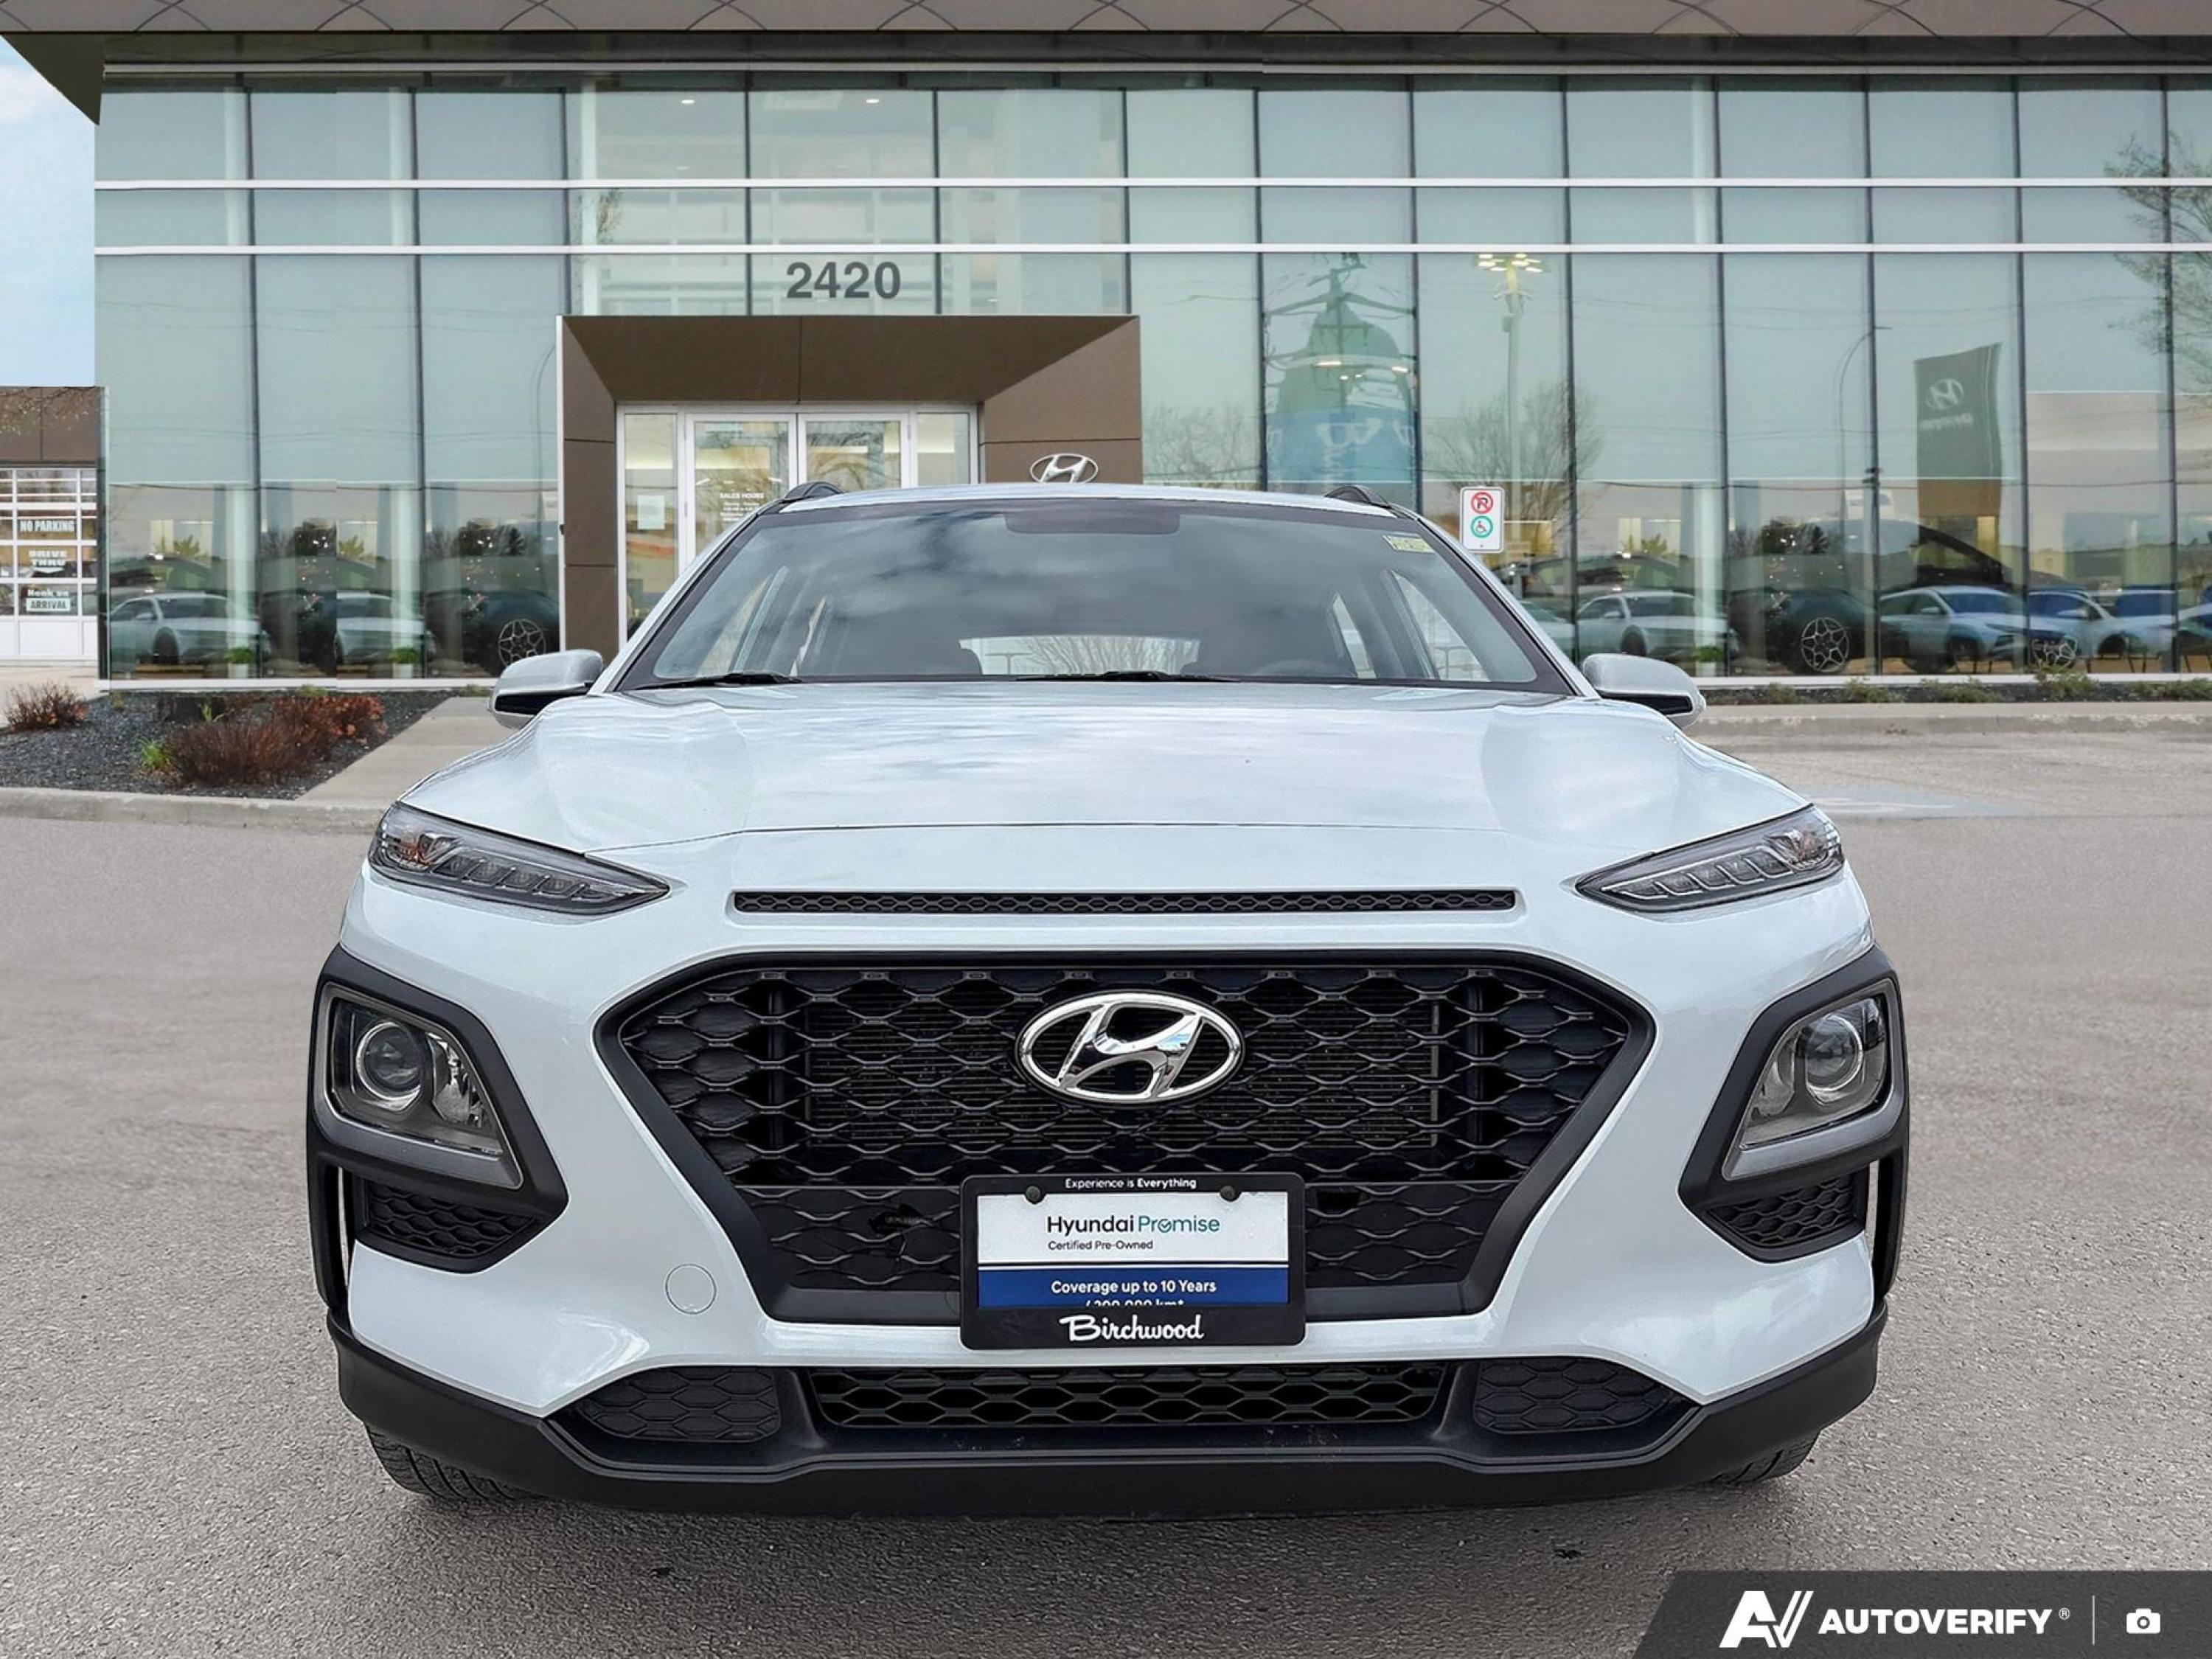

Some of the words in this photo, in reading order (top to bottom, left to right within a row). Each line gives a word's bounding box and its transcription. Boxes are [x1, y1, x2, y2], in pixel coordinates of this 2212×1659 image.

[786, 261, 901, 299] 2420
[20, 521, 32, 532] NO
[35, 521, 74, 532] PARKING
[30, 600, 67, 609] ARRIVAL
[1065, 1178, 1124, 1190] Experience
[1127, 1178, 1135, 1188] is
[1137, 1178, 1197, 1190] Everything
[1047, 1214, 1135, 1237] Hyundai
[1138, 1214, 1220, 1233] Promise
[1048, 1240, 1093, 1251] Certified
[1095, 1240, 1154, 1251] Pre-Owned
[1051, 1280, 1119, 1295] Coverage
[1121, 1282, 1140, 1295] up
[1143, 1281, 1158, 1293] to
[1161, 1280, 1177, 1293] 10
[1178, 1279, 1217, 1293] Years
[1058, 1313, 1205, 1342] Birchwood
